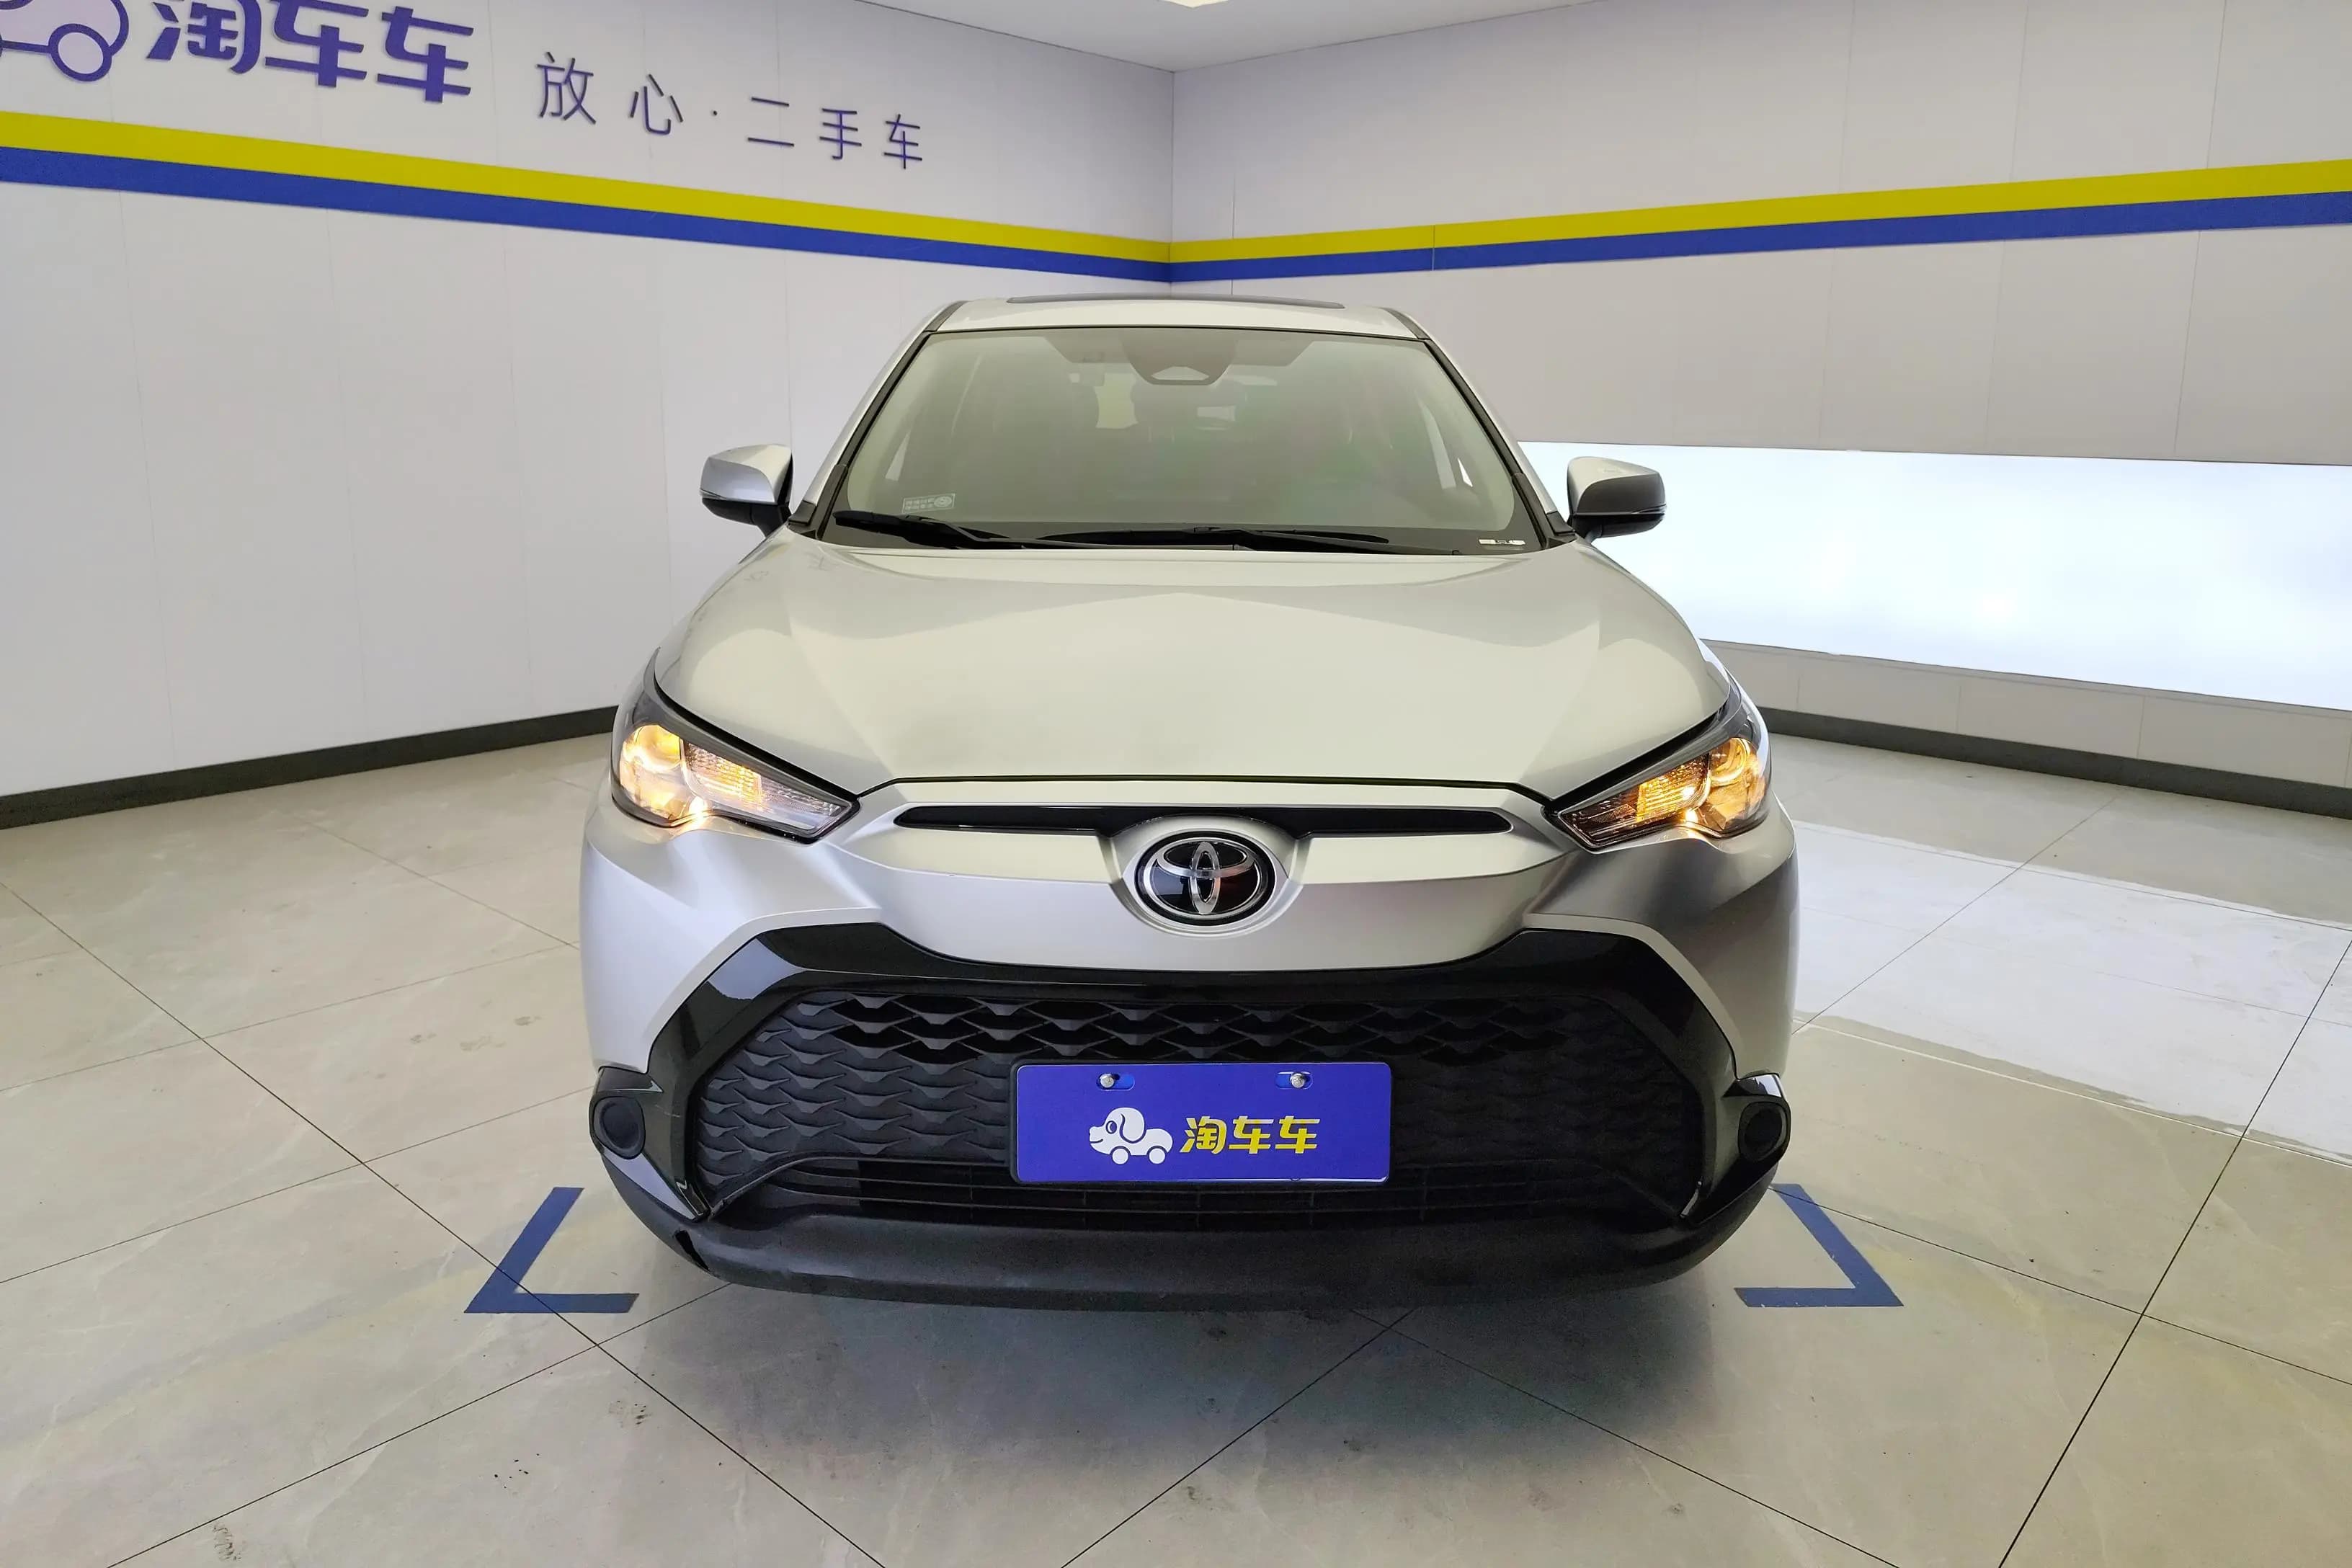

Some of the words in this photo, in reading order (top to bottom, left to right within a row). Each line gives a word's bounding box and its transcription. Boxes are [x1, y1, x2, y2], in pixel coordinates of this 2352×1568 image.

[146, 0, 473, 103] 淘车车
[1180, 1115, 1320, 1154] 淘车车
